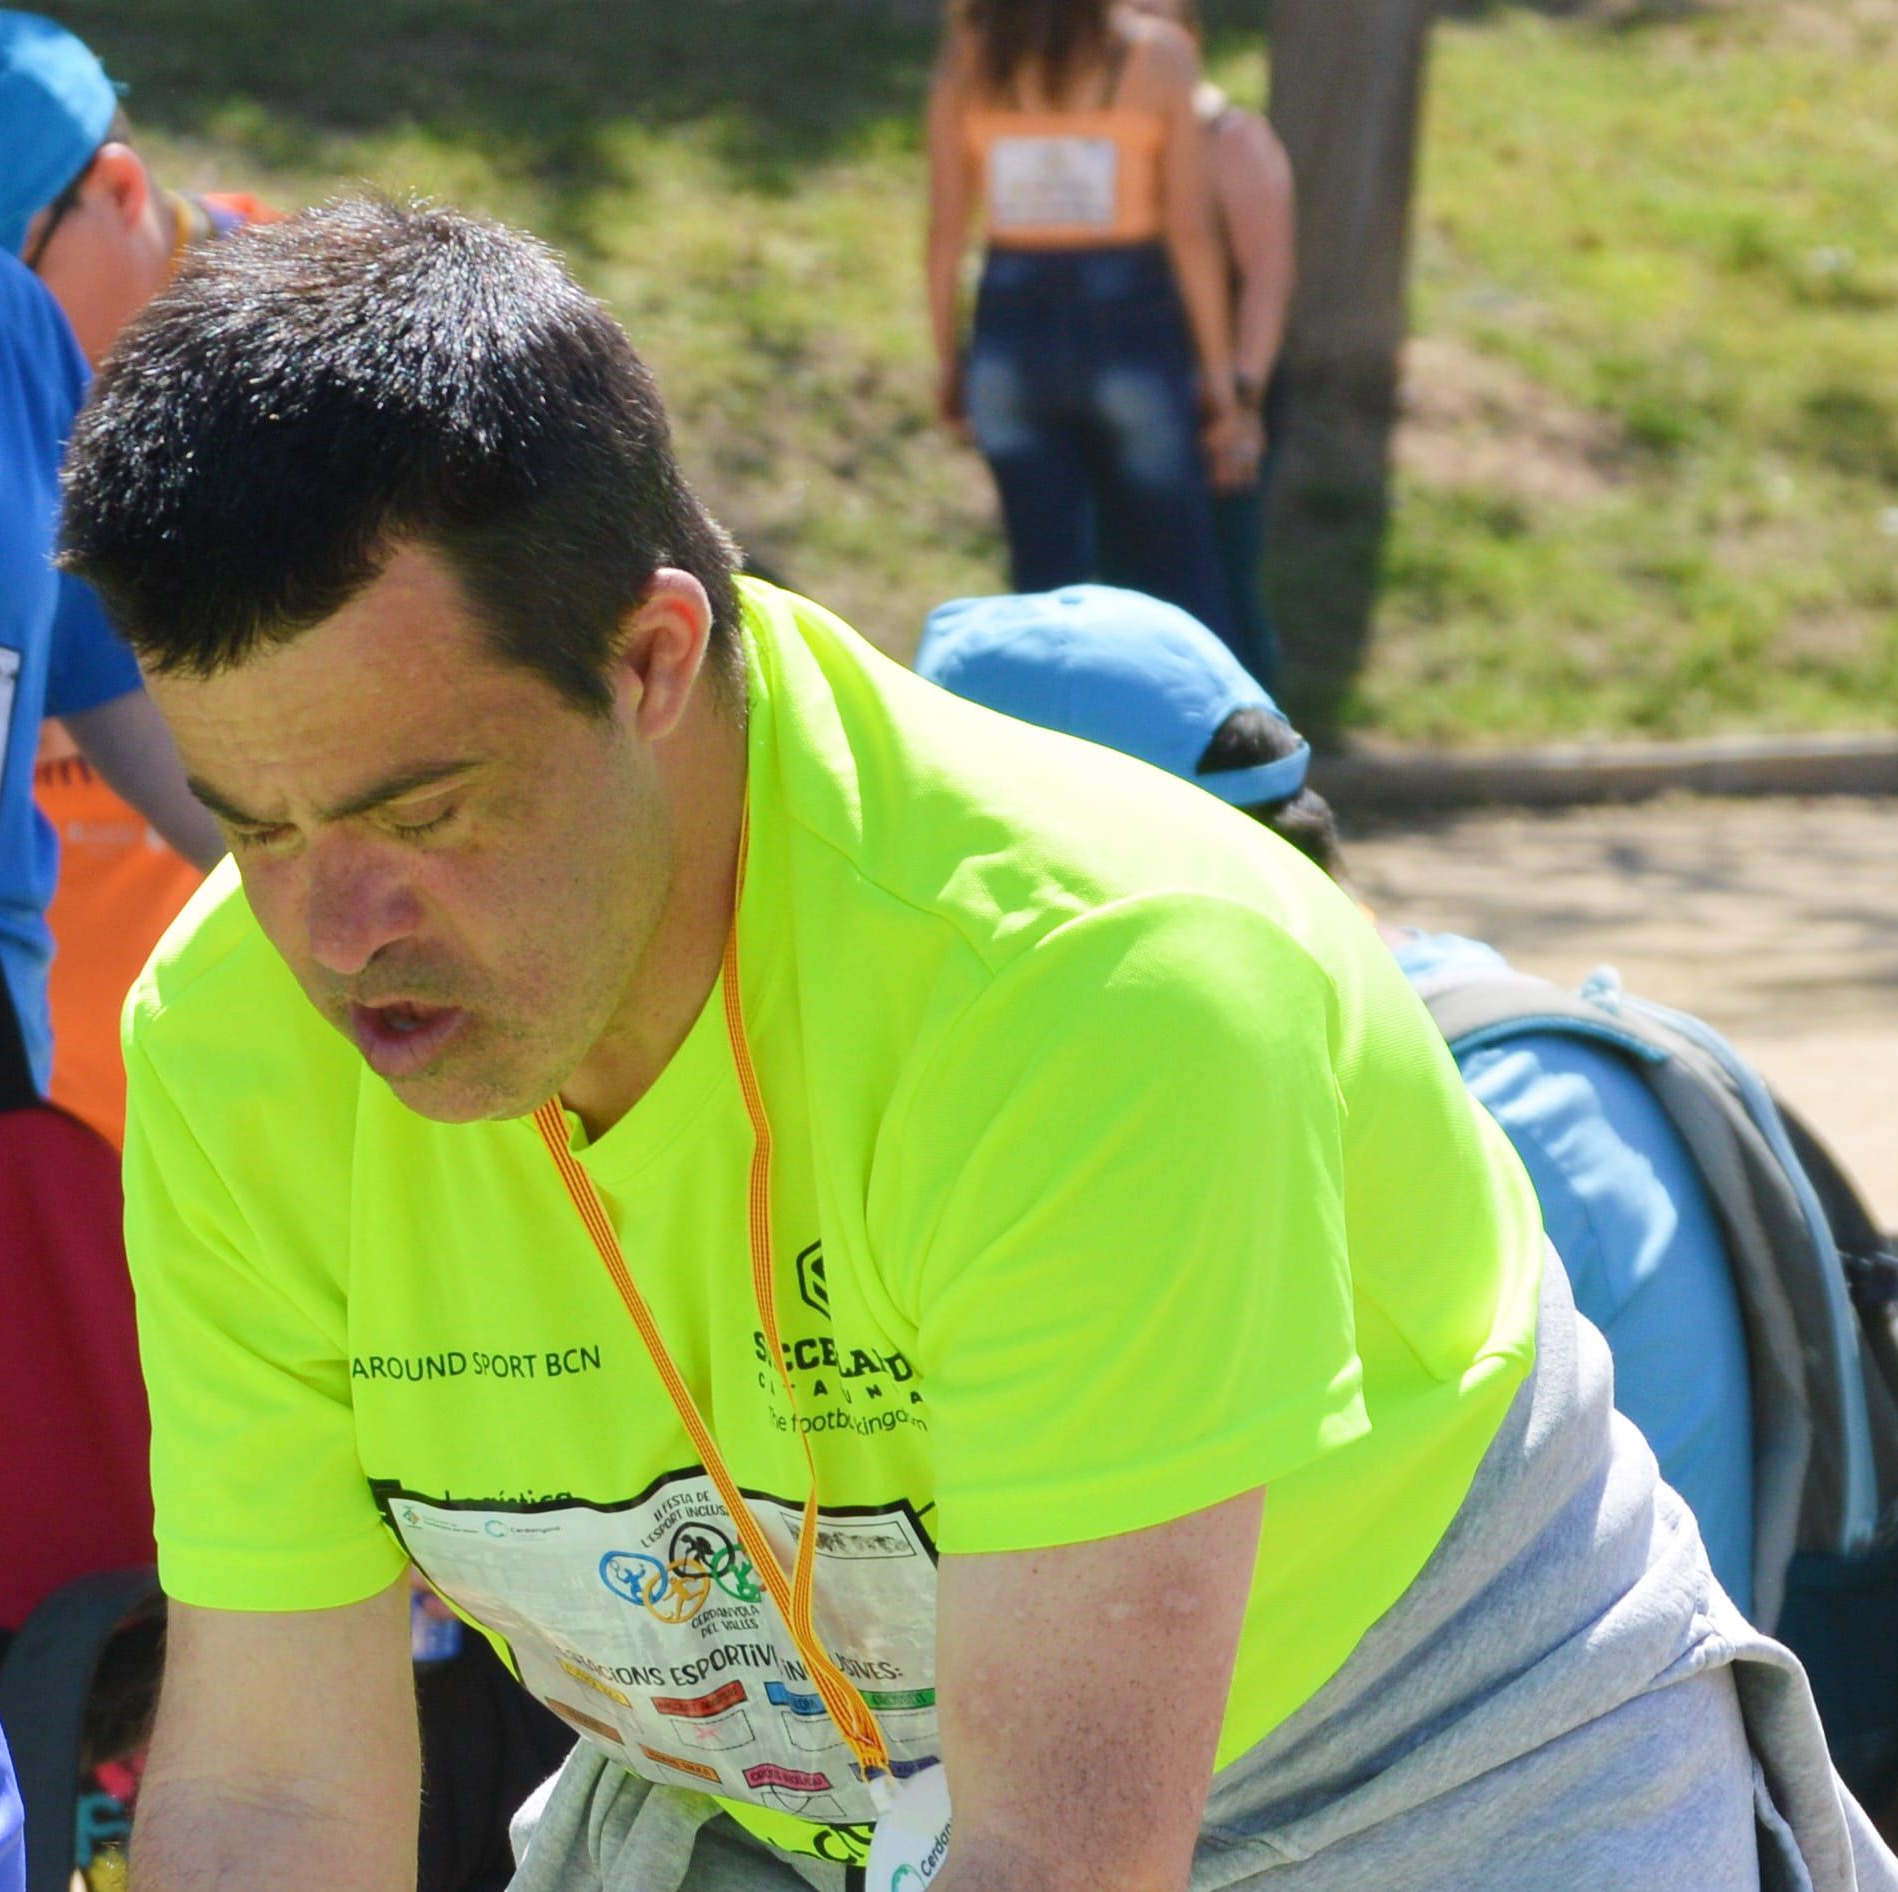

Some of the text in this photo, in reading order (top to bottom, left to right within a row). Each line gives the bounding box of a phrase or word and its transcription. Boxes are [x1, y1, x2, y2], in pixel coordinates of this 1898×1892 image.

[352, 1345, 602, 1381] AROUND SPORT BCN
[662, 1493, 695, 1515] FESTA
[696, 1490, 712, 1502] DE
[701, 1622, 719, 1639] DEL
[920, 1818, 953, 1877] Cerdan
